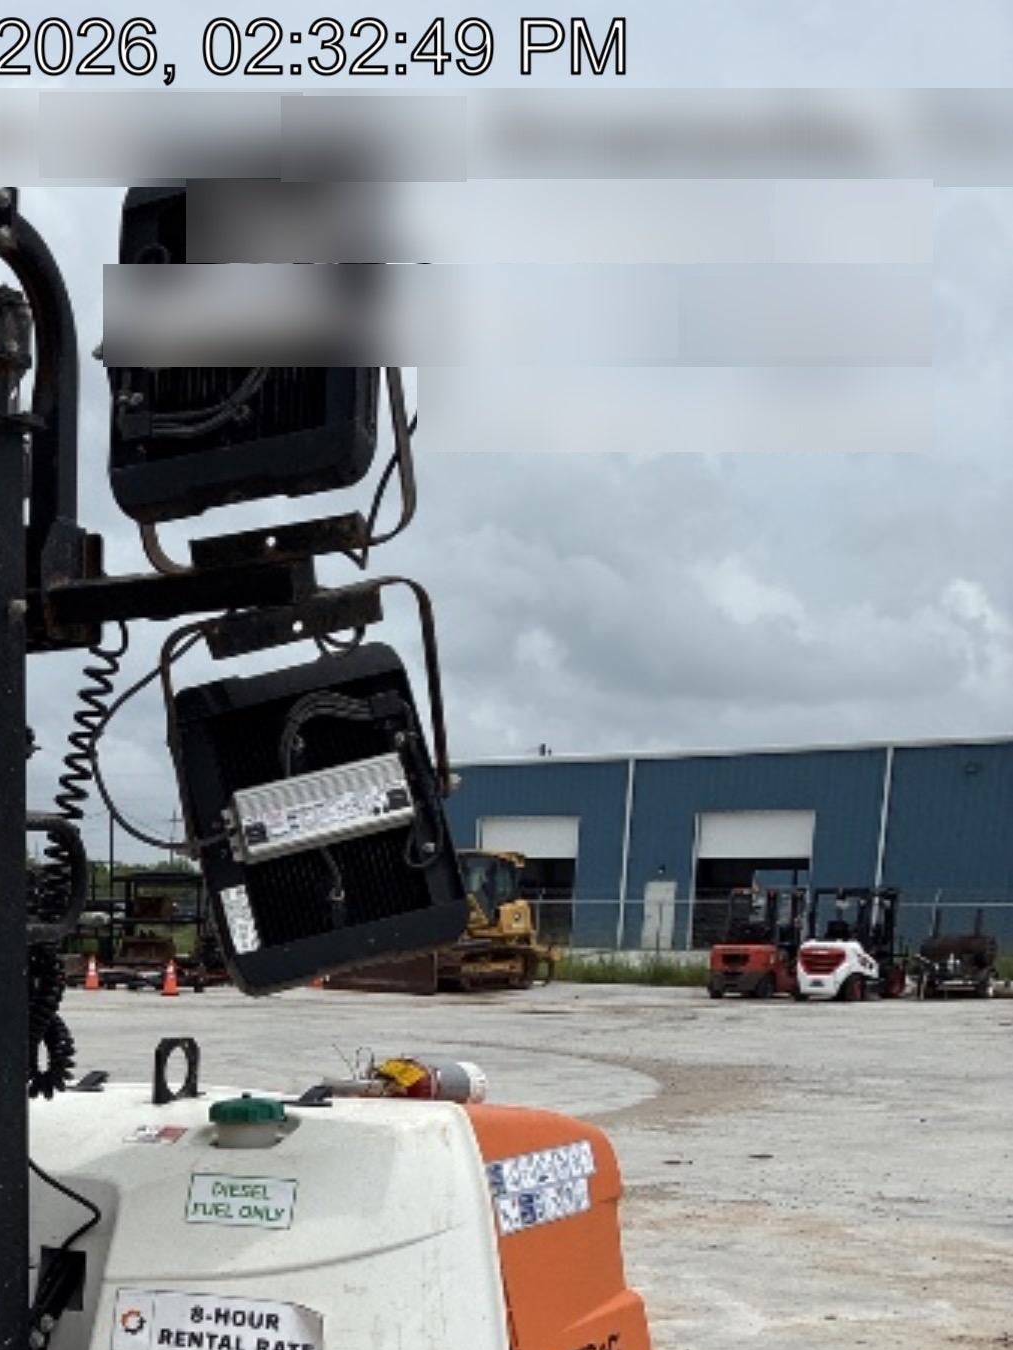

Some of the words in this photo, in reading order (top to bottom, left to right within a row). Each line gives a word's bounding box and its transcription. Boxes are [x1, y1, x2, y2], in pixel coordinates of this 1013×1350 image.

[211, 1181, 270, 1200] DIESEL
[190, 1202, 234, 1218] FUEL
[238, 1205, 285, 1222] ONLY
[190, 1306, 280, 1331] 8-HOUR
